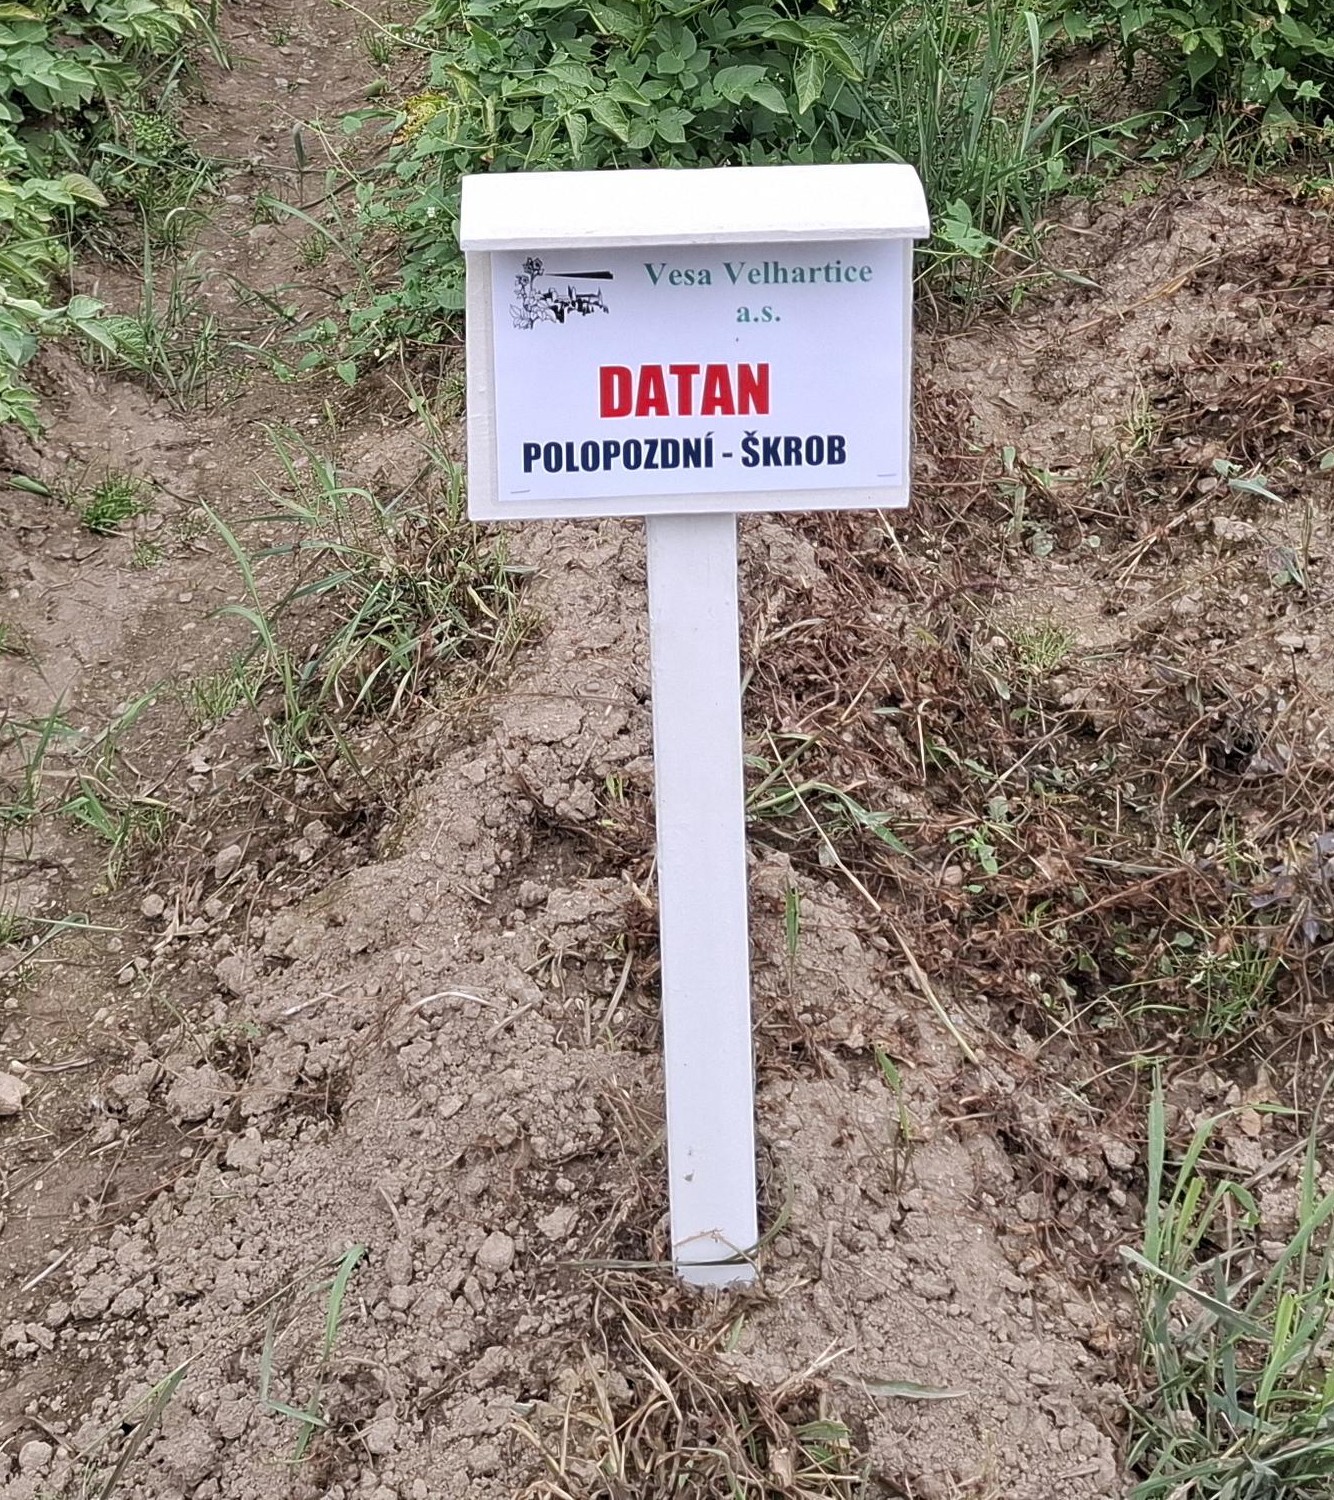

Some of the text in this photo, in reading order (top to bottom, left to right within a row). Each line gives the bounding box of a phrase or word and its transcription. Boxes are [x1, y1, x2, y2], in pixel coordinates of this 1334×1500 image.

[643, 259, 874, 287] Vesa Velhartice
[735, 304, 781, 324] a.s.
[598, 362, 770, 419] DATAN
[522, 431, 715, 474] POLOPOZDNÍ
[741, 430, 847, 468] ŠKROB
